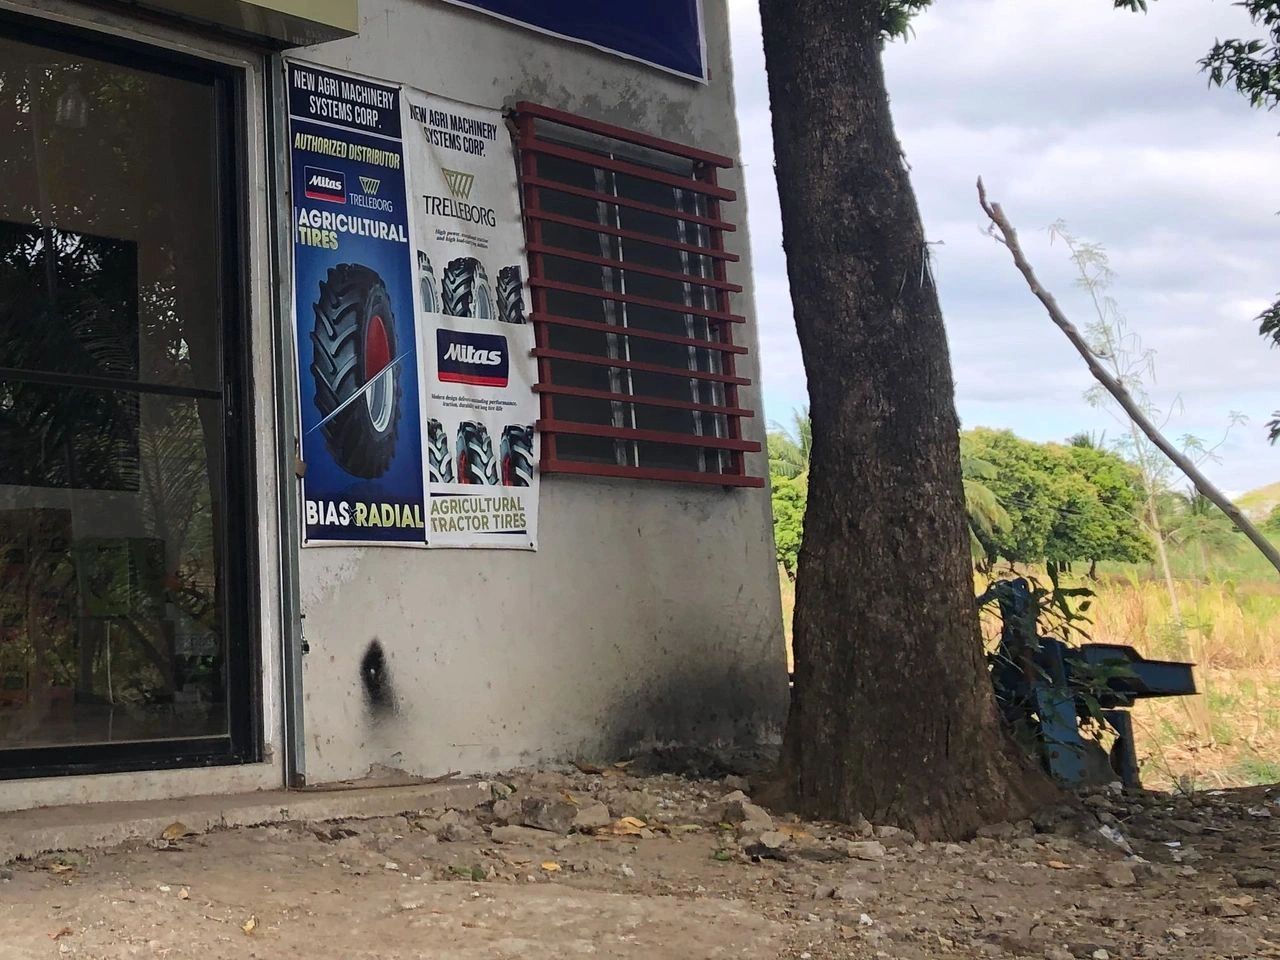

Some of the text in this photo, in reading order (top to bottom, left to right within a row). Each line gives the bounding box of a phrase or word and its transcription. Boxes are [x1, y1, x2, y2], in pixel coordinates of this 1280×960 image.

[294, 69, 394, 110] NEW AGRI MACHINERY
[310, 95, 382, 129] SYSTEMS CORP.
[409, 104, 497, 141] NEW AGRI MACHINERY
[294, 132, 401, 170] AUTHORIZED DISTRIBUTOR
[423, 127, 486, 158] SYSTEMS CORP.
[309, 175, 342, 191] Mitas
[349, 192, 393, 213] TRELLEBORG
[423, 195, 496, 227] TRELLEBORG
[298, 207, 408, 243] AGRICULTURAL
[298, 226, 339, 251] TIRES
[443, 342, 502, 365] Mitas
[306, 500, 350, 526] BIAS
[356, 502, 424, 528] RADIAL
[430, 496, 525, 516] AGRICULTURAL
[430, 512, 527, 533] TRACTOR TIRES
